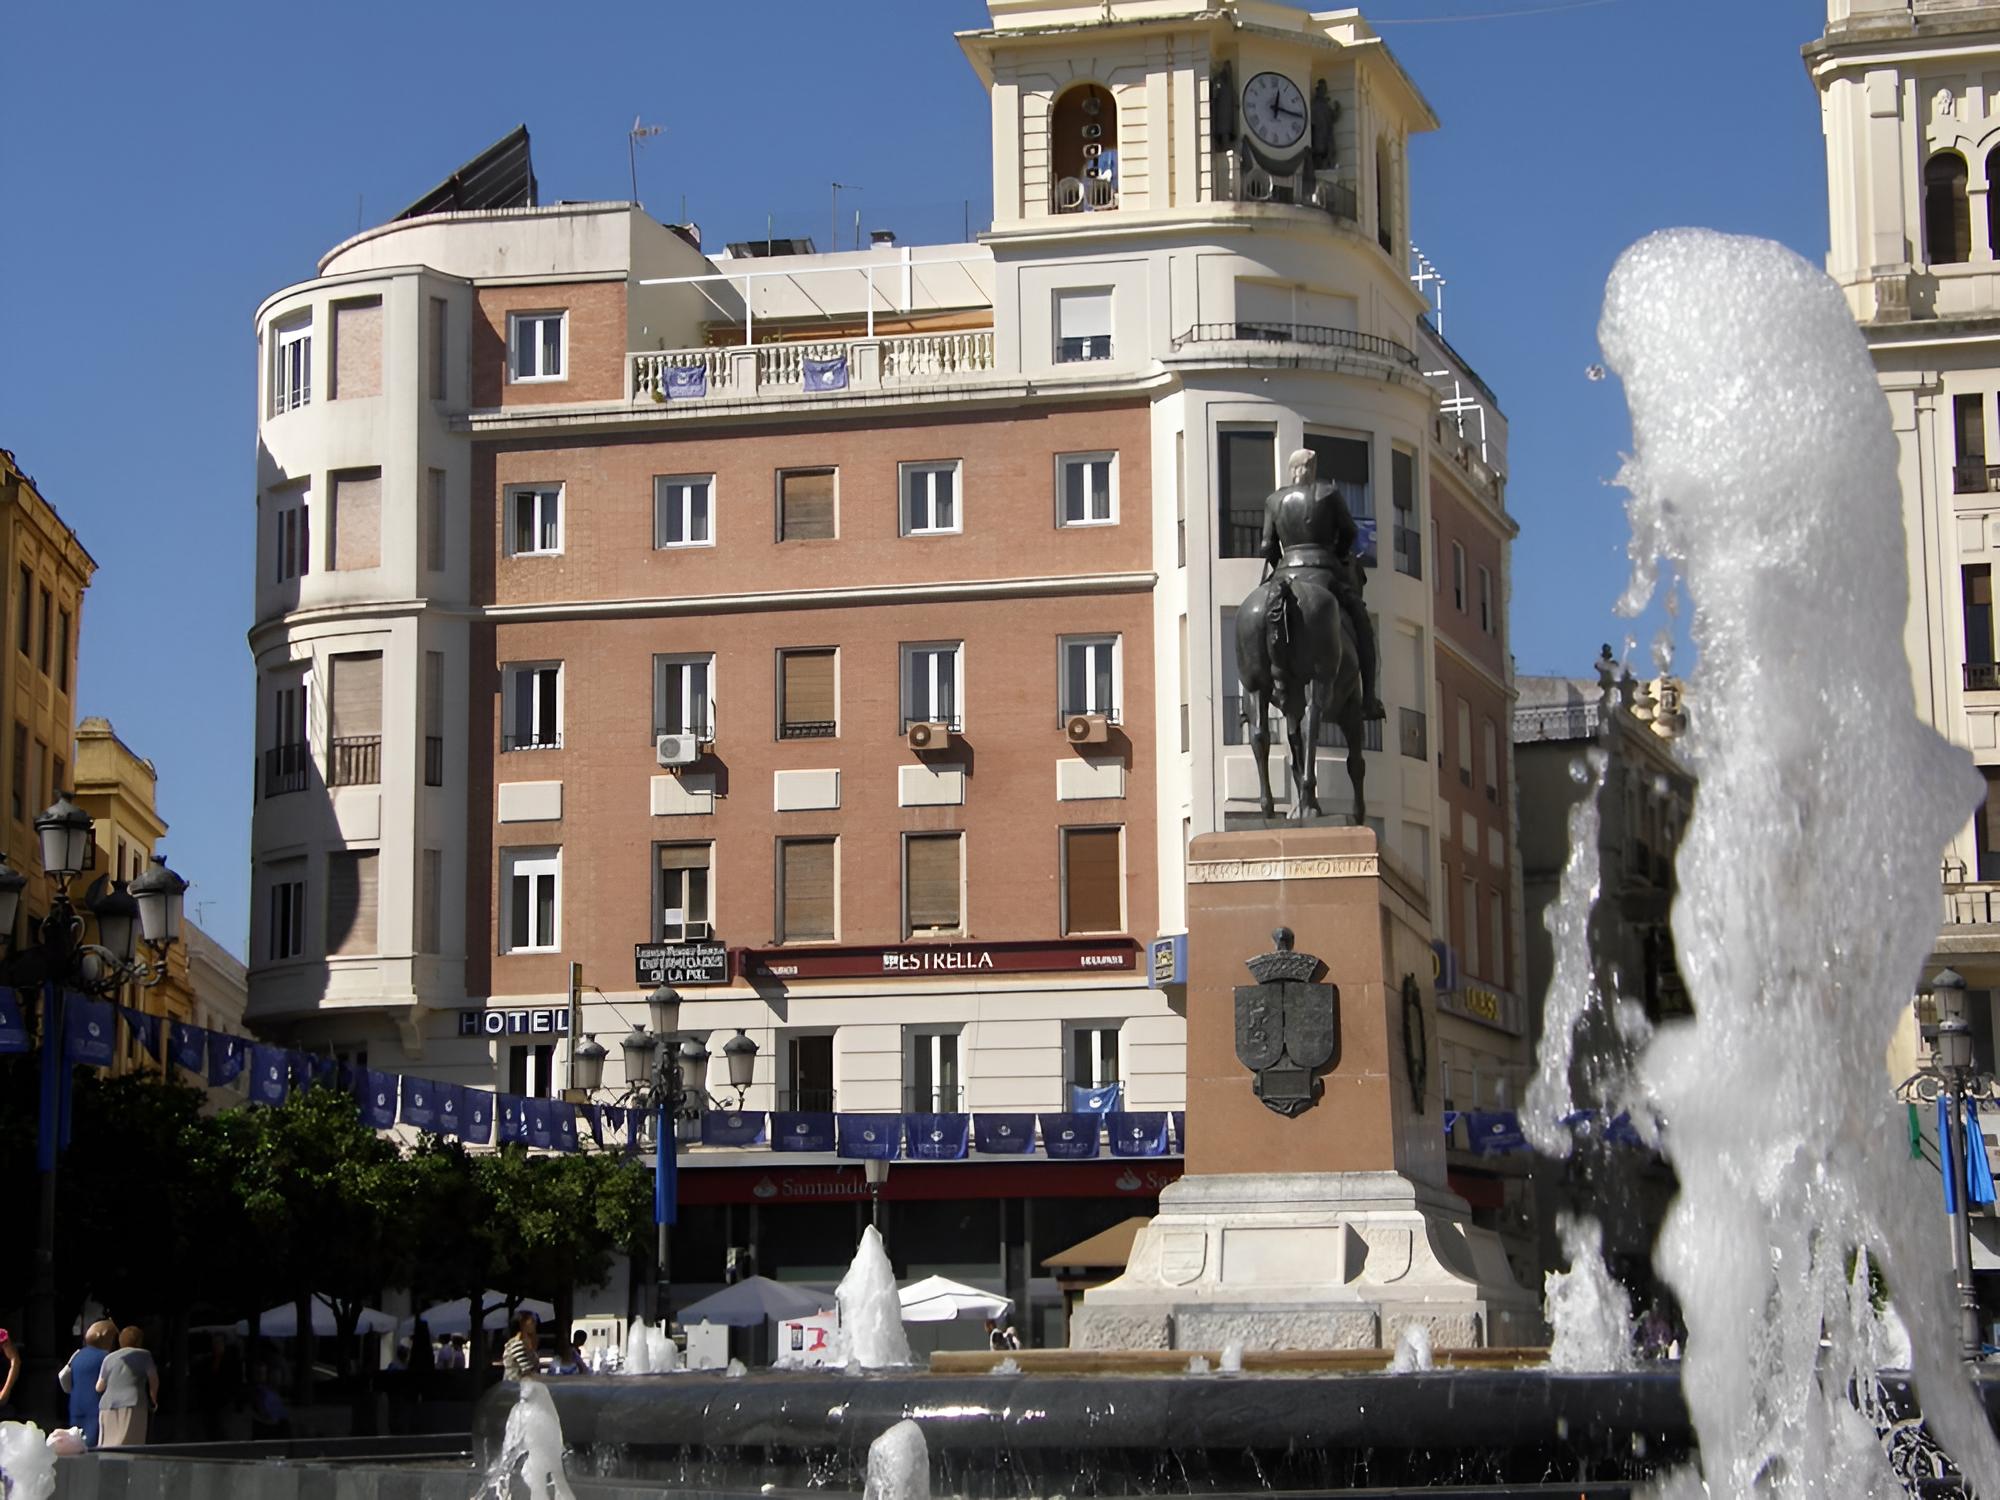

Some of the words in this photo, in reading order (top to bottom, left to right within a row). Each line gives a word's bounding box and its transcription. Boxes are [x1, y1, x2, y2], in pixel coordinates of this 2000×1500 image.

[899, 952, 994, 970] ESTRELLA
[462, 1010, 569, 1033] HOTEL
[782, 1176, 870, 1196] Santand
